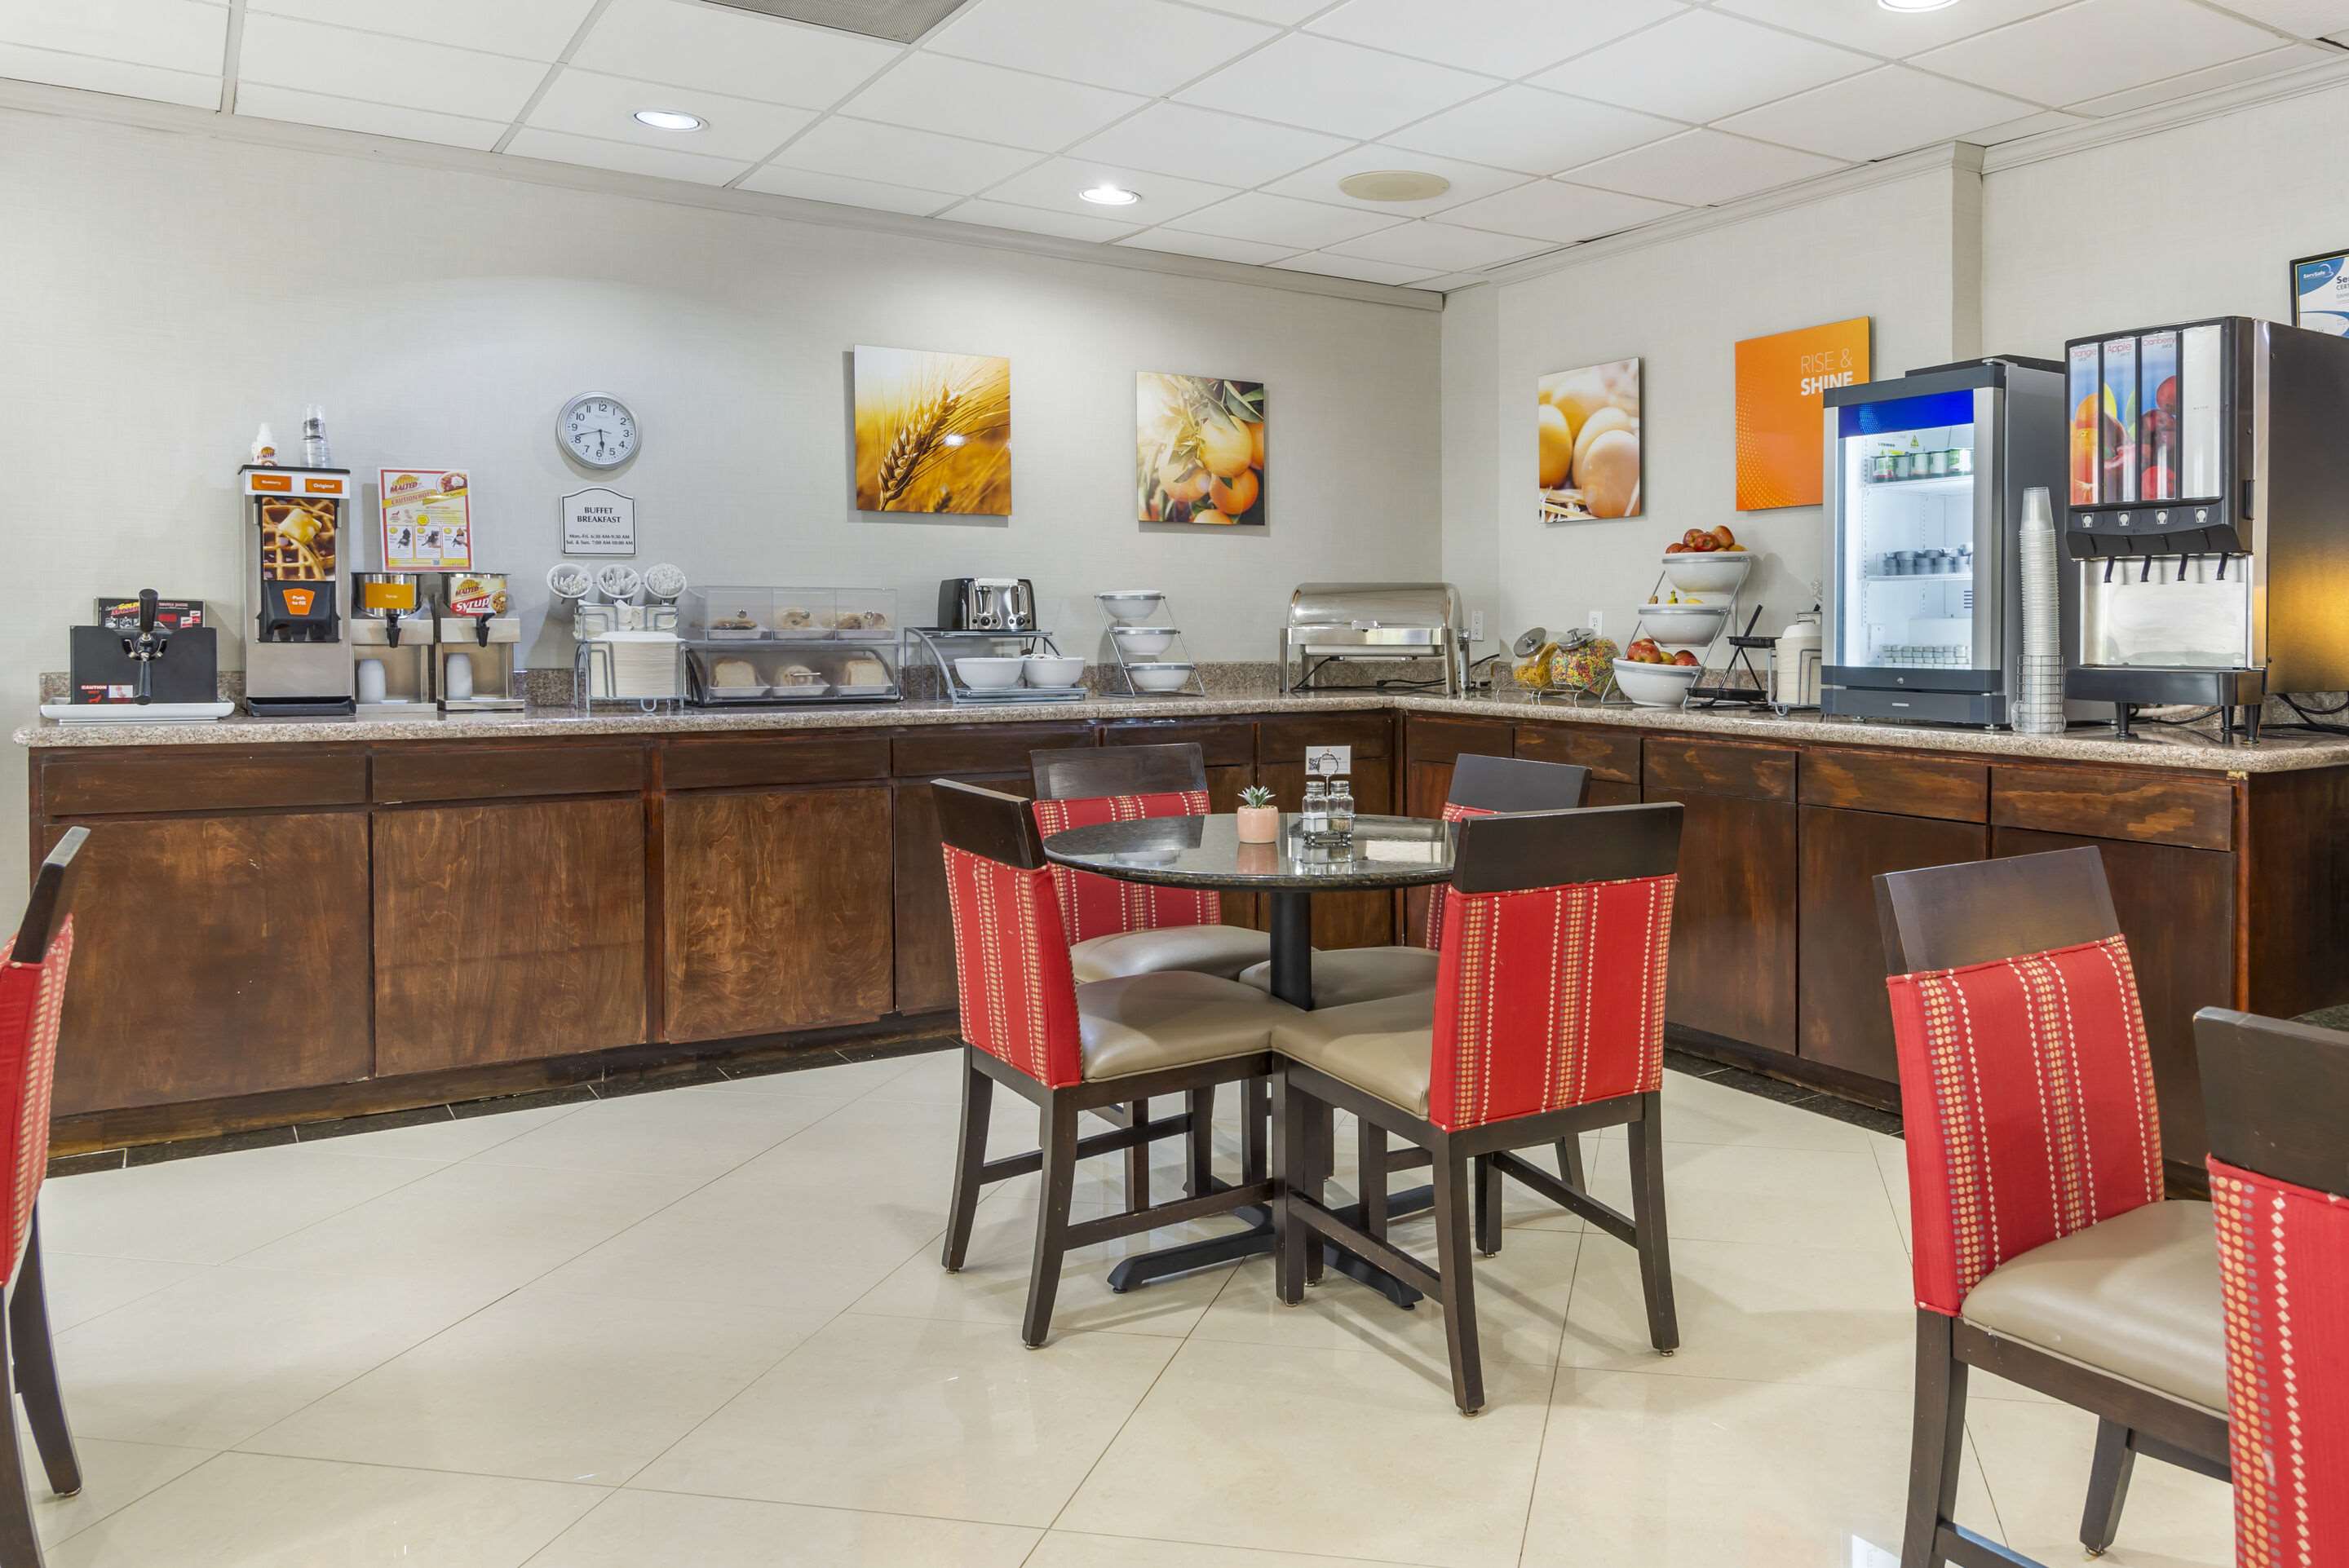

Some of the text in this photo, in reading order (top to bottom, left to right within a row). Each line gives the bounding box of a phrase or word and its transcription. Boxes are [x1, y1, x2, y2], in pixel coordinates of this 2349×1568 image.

[2303, 271, 2325, 279] ServSafe
[2143, 337, 2176, 347] Cranberry
[2107, 342, 2131, 354] Apple
[2071, 348, 2097, 359] Orange
[1801, 347, 1853, 374] RISE &
[1800, 371, 1853, 396] SHINE
[586, 405, 591, 413] 11
[599, 403, 608, 412] 12
[576, 412, 585, 422] 10
[620, 417, 626, 426] 2
[571, 423, 578, 431] 9
[623, 430, 630, 438] 3
[574, 435, 582, 444] 8
[619, 440, 625, 448] 4
[609, 448, 616, 456] 5
[390, 481, 418, 492] MALTED
[455, 586, 480, 596] MALTED
[456, 597, 489, 613] Syrup
